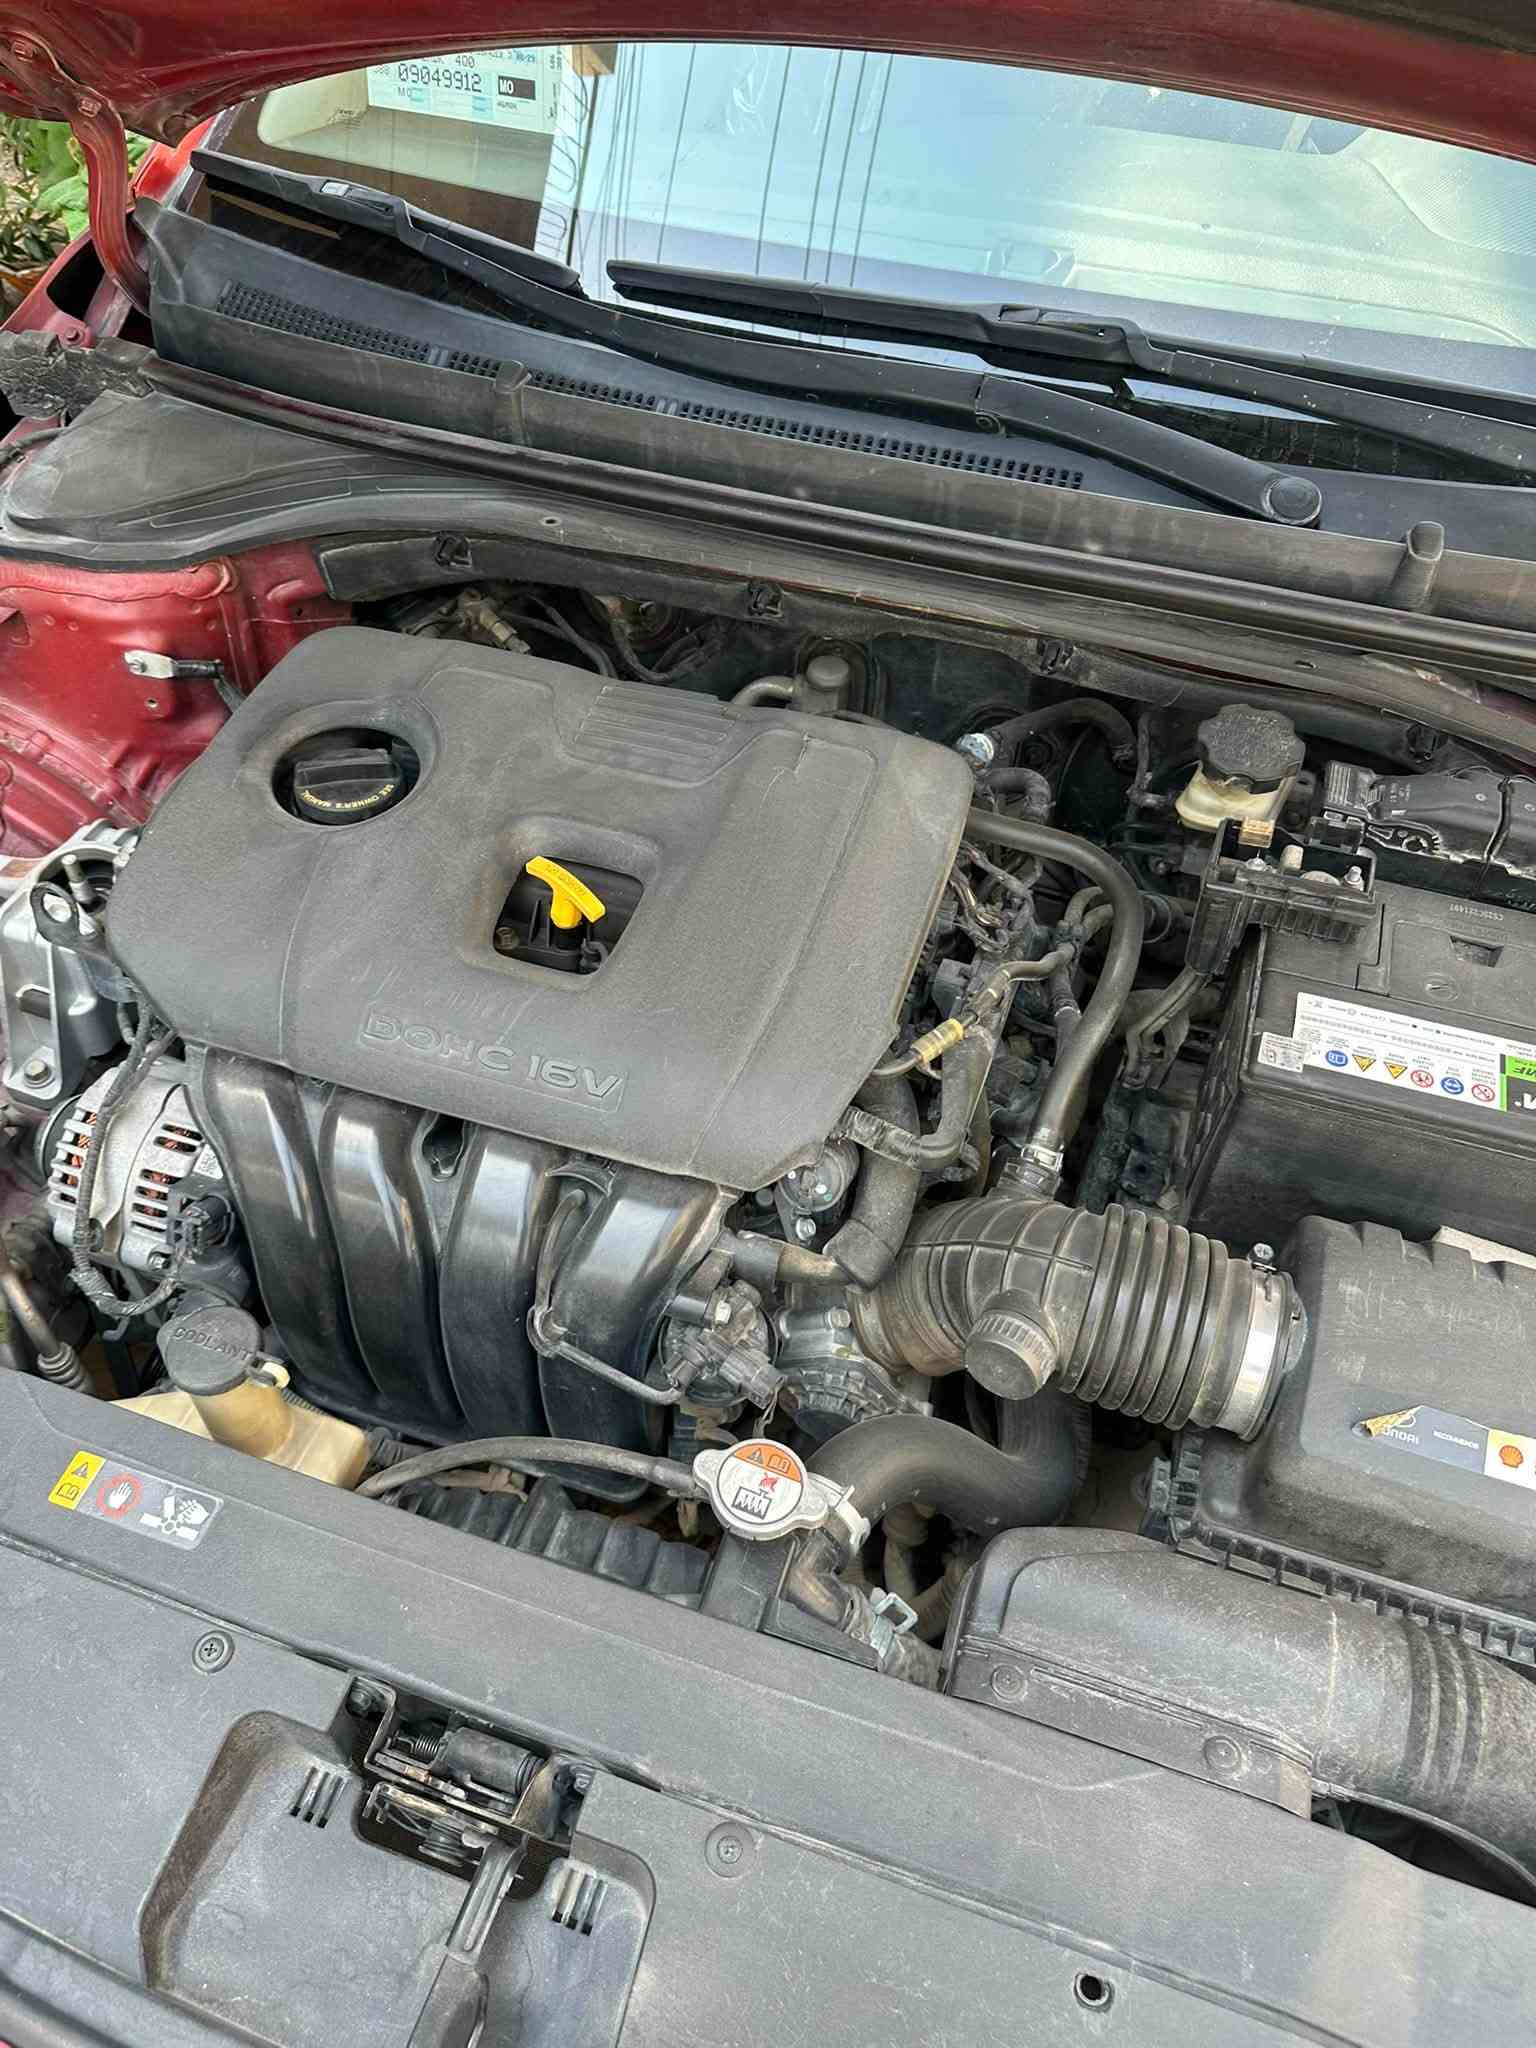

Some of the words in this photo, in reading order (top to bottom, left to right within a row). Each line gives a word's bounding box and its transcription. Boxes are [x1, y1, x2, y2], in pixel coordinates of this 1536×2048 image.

[398, 63, 482, 93] 09049912
[499, 78, 515, 95] MO
[363, 1012, 514, 1072] DOHC
[527, 1054, 621, 1099] 16V
[174, 1326, 250, 1361] COOLANT
